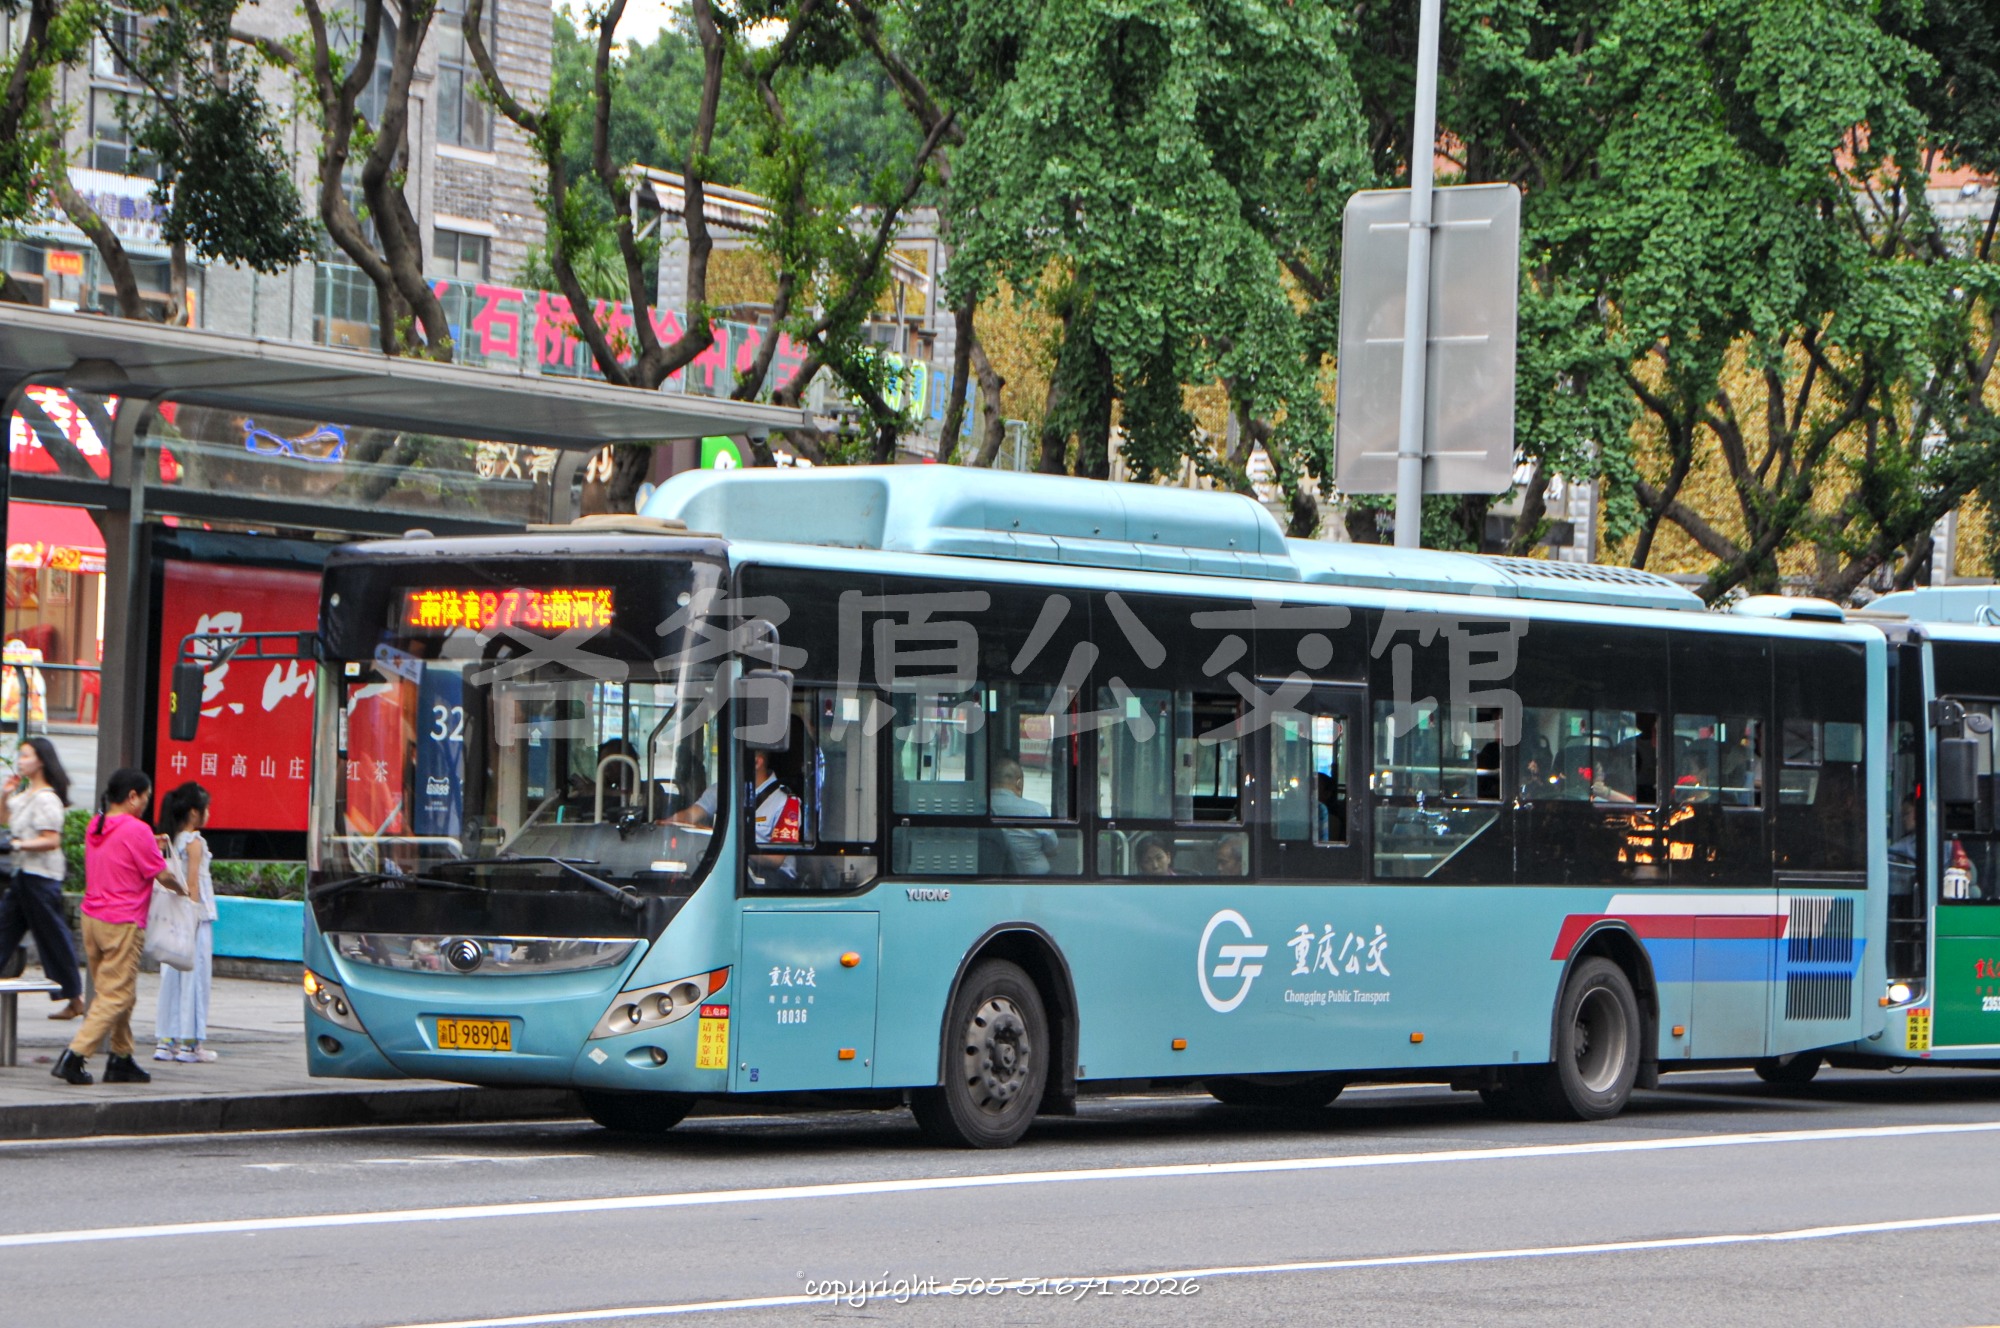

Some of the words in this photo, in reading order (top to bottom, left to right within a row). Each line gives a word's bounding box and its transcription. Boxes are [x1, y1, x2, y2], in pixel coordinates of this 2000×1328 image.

[481, 592, 542, 626] 873
[906, 888, 950, 901] YUTONG
[1287, 924, 1391, 977] 重庆公交
[769, 966, 816, 988] 重庆公交
[1284, 989, 1326, 1005] Chongqing
[1328, 989, 1351, 1003] Public
[1353, 990, 1390, 1005] Transport
[777, 1008, 807, 1024] 18036
[714, 1022, 726, 1066] 视线盲区
